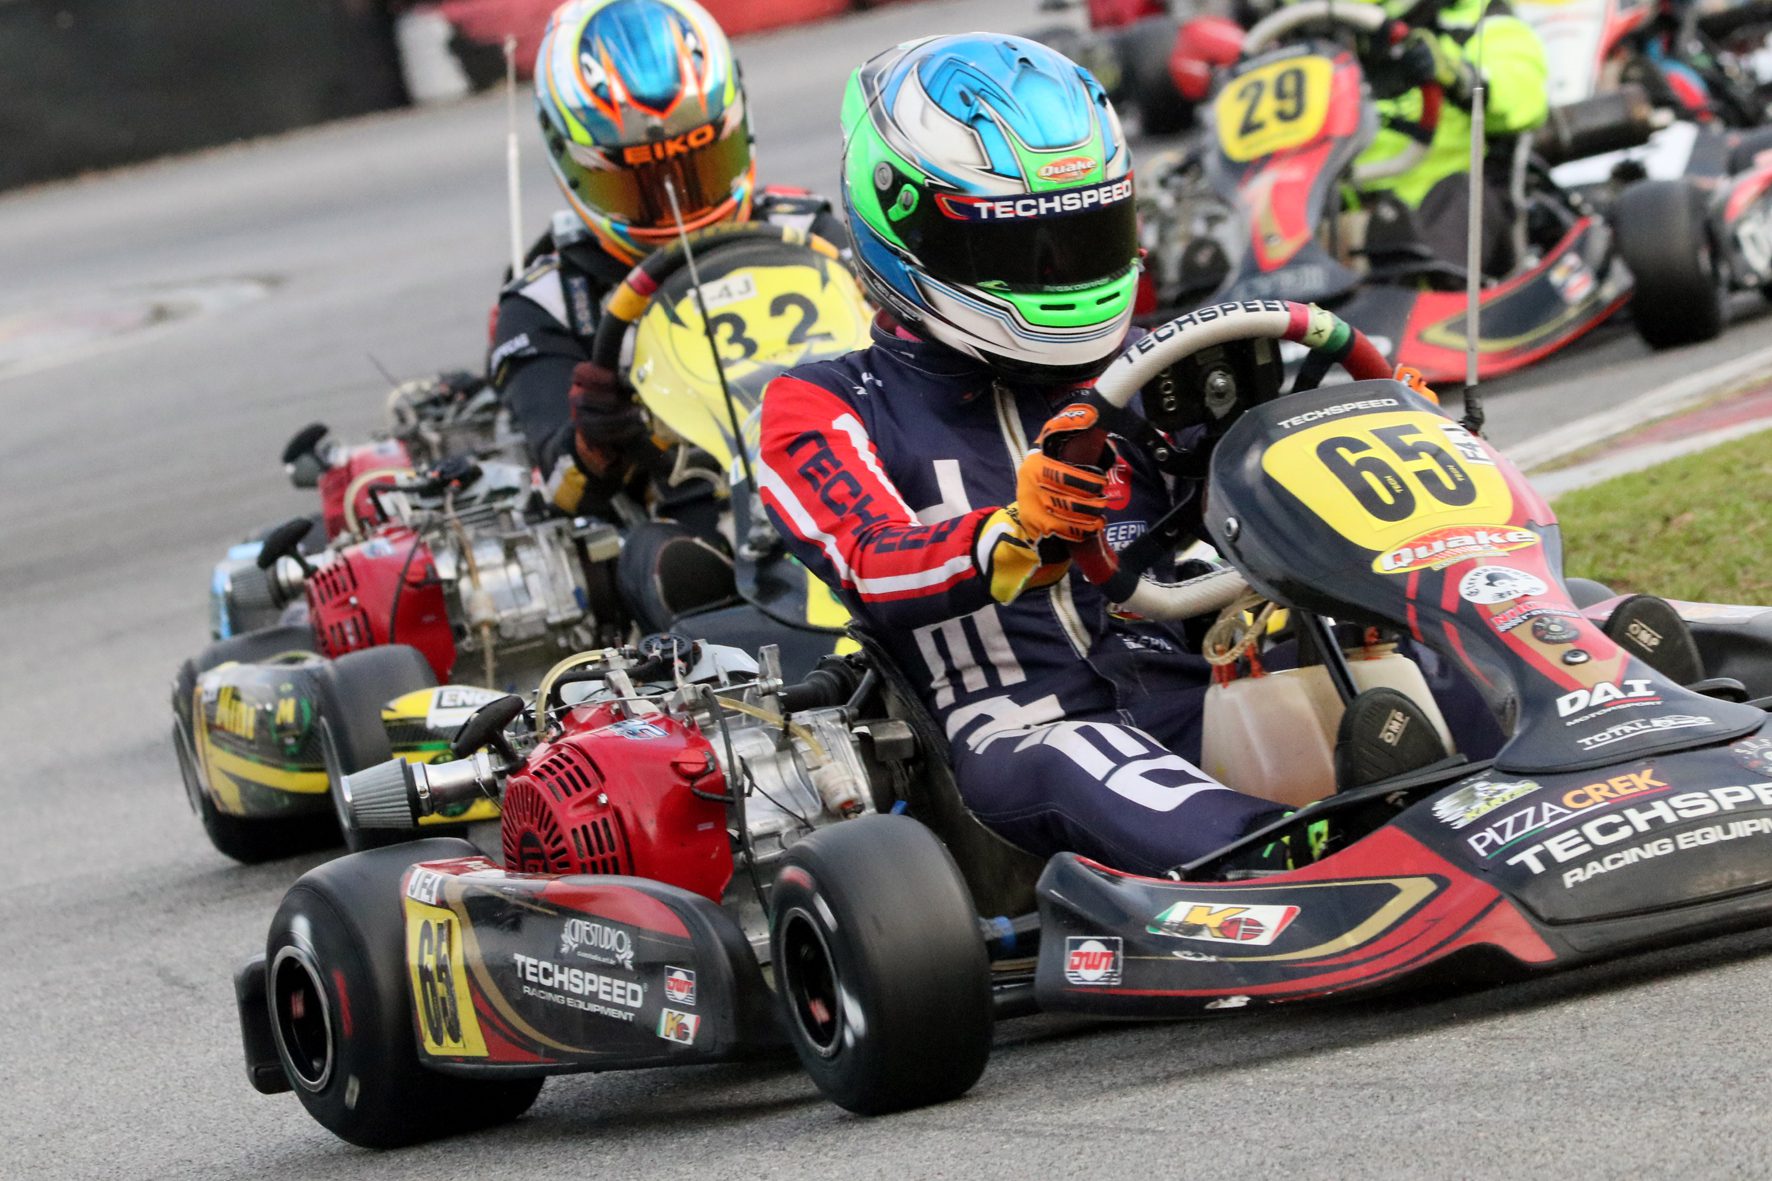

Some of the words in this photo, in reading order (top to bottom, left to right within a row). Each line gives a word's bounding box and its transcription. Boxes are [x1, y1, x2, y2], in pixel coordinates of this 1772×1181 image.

[1237, 67, 1306, 139] 29
[624, 124, 715, 164] EIKO
[1039, 159, 1097, 177] Quake
[973, 180, 1133, 219] TECHSPEED
[704, 292, 834, 368] 32
[1277, 398, 1399, 429] TECHSPEED
[1316, 423, 1477, 523] 65
[1381, 531, 1535, 571] Quake
[1556, 679, 1656, 718] DAI
[1562, 837, 1675, 889] RACING
[513, 952, 644, 1009] TECHSPEED
[522, 985, 566, 1006] RACING
[566, 996, 635, 1022] EQUIPMENT
